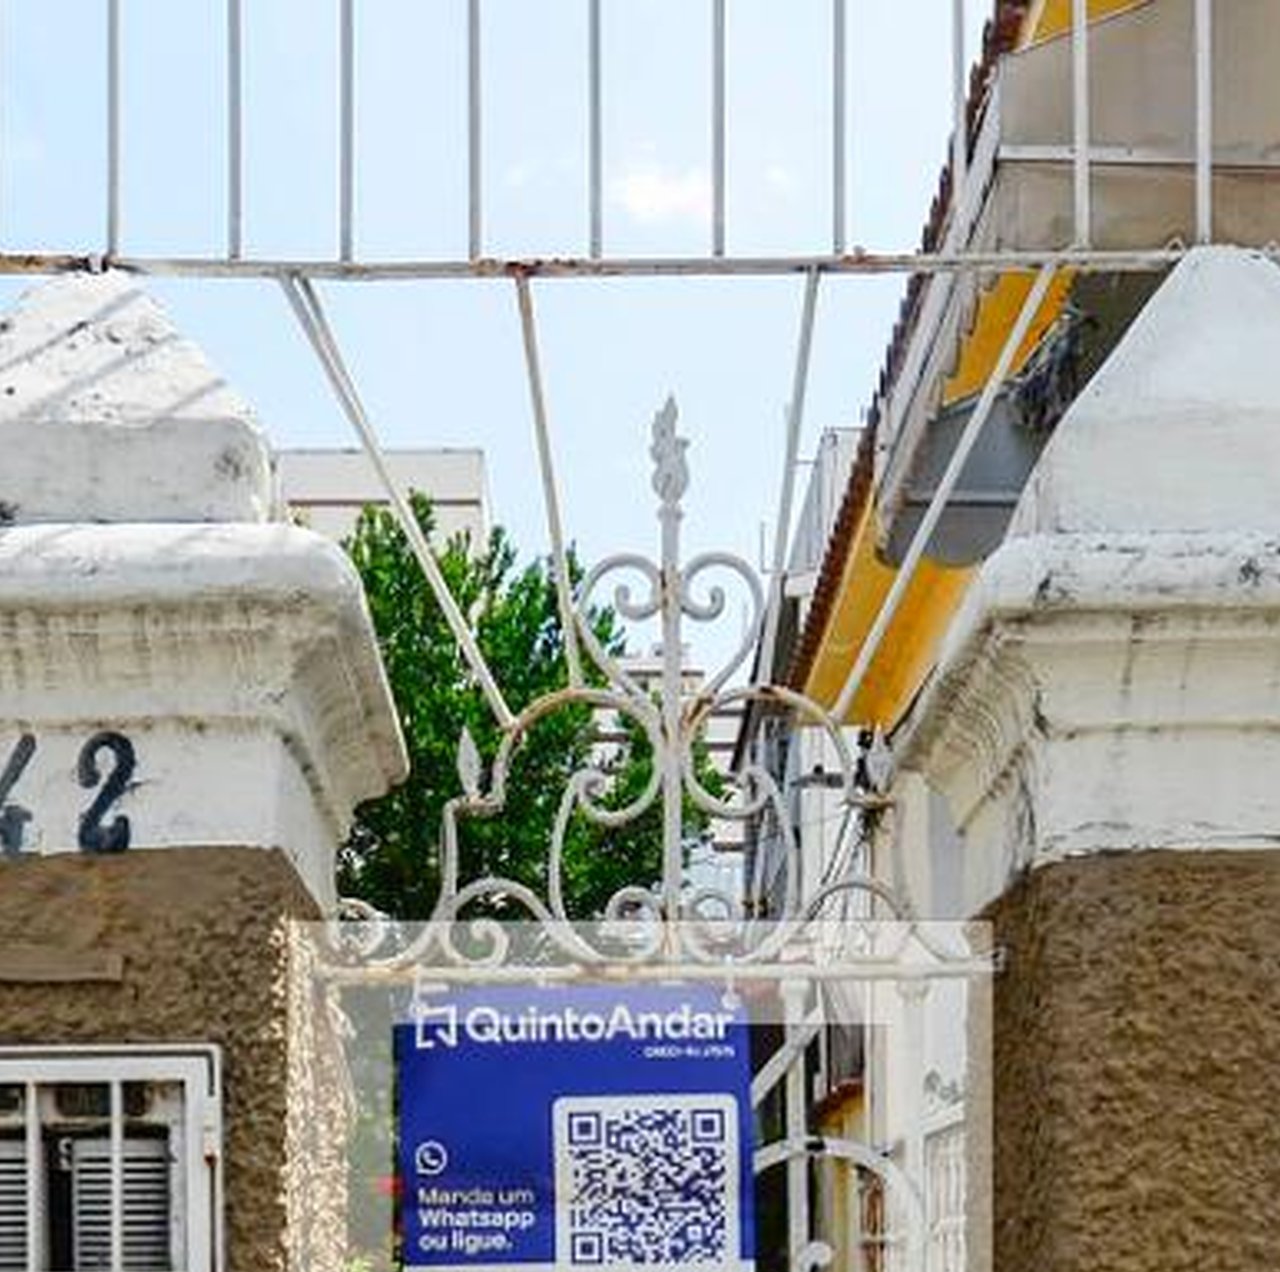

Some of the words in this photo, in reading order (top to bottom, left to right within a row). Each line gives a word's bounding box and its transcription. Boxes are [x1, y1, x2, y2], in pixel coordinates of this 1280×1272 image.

[464, 1003, 735, 1044] QuintoAndar
[498, 1188, 534, 1205] um
[418, 1207, 536, 1232] Whatsapp
[419, 1233, 448, 1251] ou
